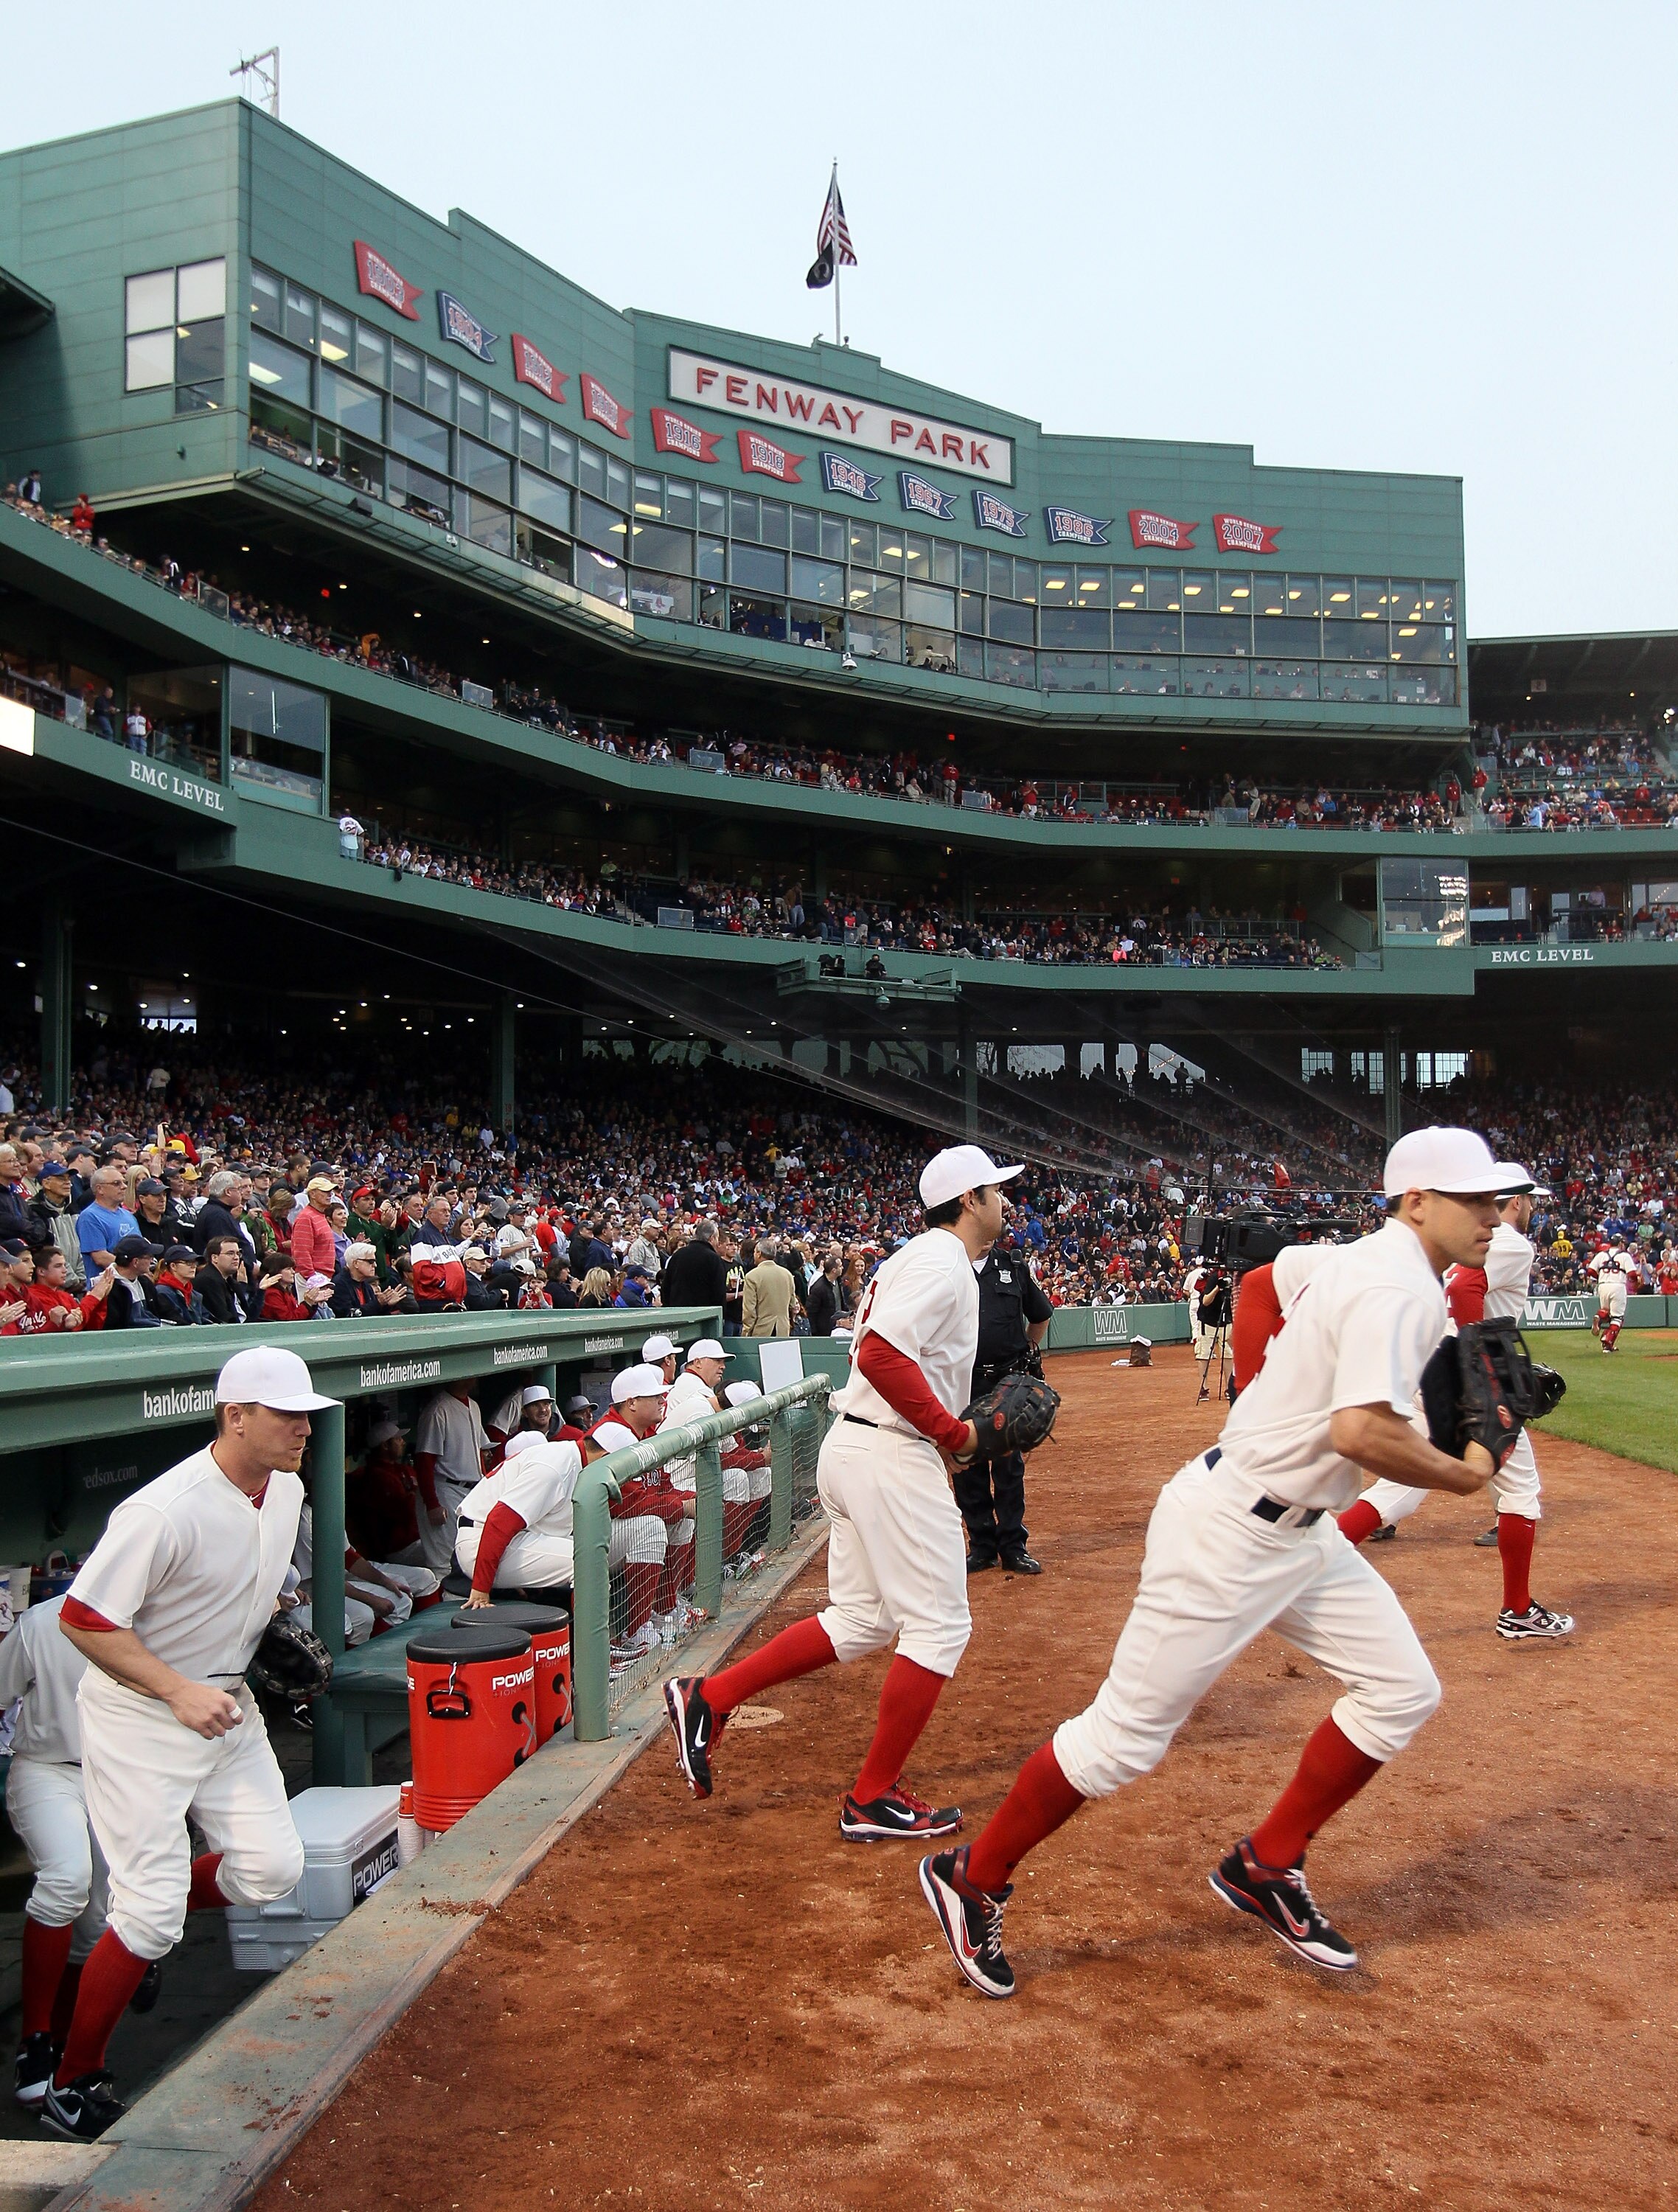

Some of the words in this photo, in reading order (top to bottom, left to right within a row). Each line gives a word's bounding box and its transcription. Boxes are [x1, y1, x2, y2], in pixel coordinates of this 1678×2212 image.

[367, 260, 405, 303] 1903
[448, 307, 482, 349] 1904
[697, 367, 864, 434] FENWAY
[891, 419, 991, 469] PARK
[666, 422, 701, 451] 1916
[666, 439, 700, 457] CHAMPIONS
[751, 443, 784, 471] 1918
[752, 459, 784, 477] CHAMPIONS
[831, 463, 866, 491] 1946
[908, 483, 942, 509] 1967
[983, 501, 1014, 528] 1975
[1141, 515, 1159, 523] WORLD
[1223, 518, 1243, 526] WORLD
[1243, 522, 1261, 532] SERIES
[1054, 516, 1093, 537] 1986
[1058, 531, 1091, 543] CHAMPIONS
[1138, 520, 1179, 542] 2004
[1222, 524, 1264, 545] 2007
[1143, 535, 1176, 546] CHAMPIONS
[1227, 539, 1261, 551] CHAMPIONS
[130, 759, 168, 790] EMC
[173, 776, 224, 811] LEVEL
[1491, 950, 1531, 962] EMC
[1536, 949, 1594, 961] LEVEL
[1524, 1300, 1586, 1320] WM
[1093, 1310, 1127, 1335] WM
[493, 1343, 548, 1365] bankofamerica.com
[585, 1335, 624, 1353] bankofamerica.com
[361, 1360, 441, 1388] bankofamerica.com
